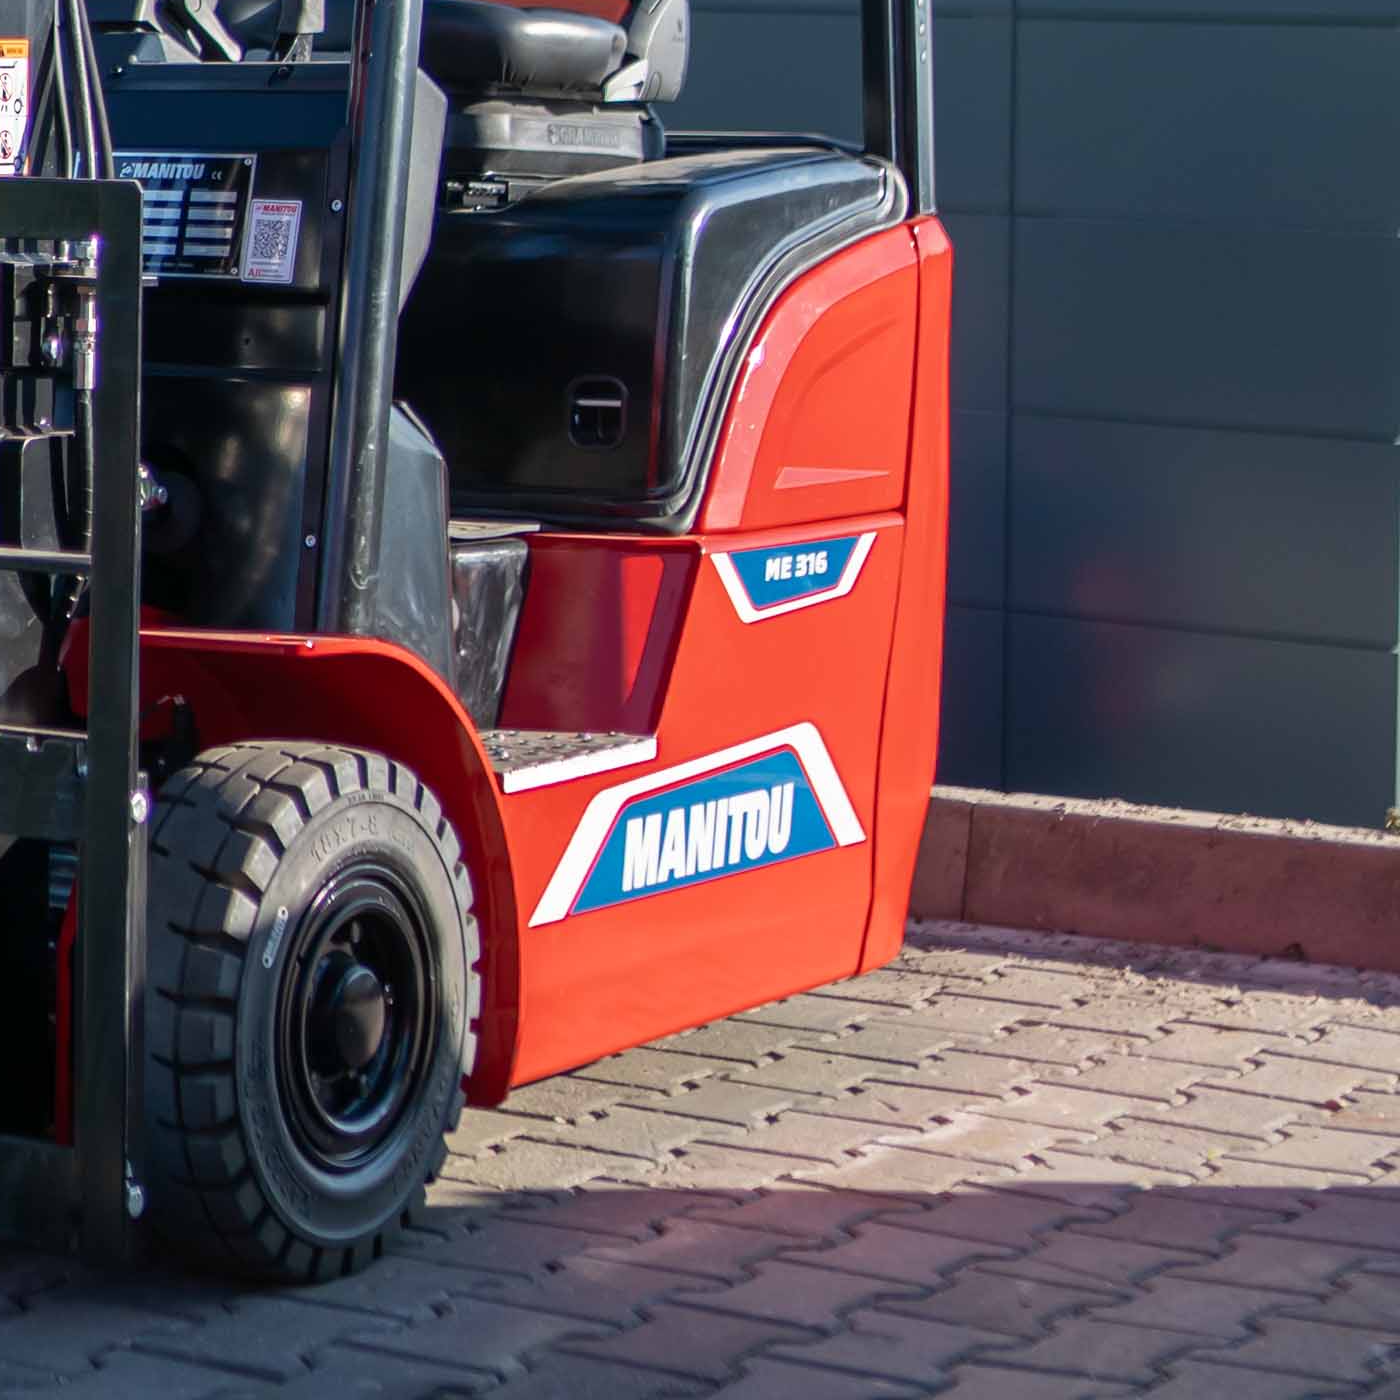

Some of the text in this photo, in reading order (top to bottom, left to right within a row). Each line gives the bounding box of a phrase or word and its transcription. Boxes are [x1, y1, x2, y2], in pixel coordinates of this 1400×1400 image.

[133, 162, 205, 180] MANITOU
[764, 550, 829, 582] ME 316
[621, 782, 795, 893] MANITOU
